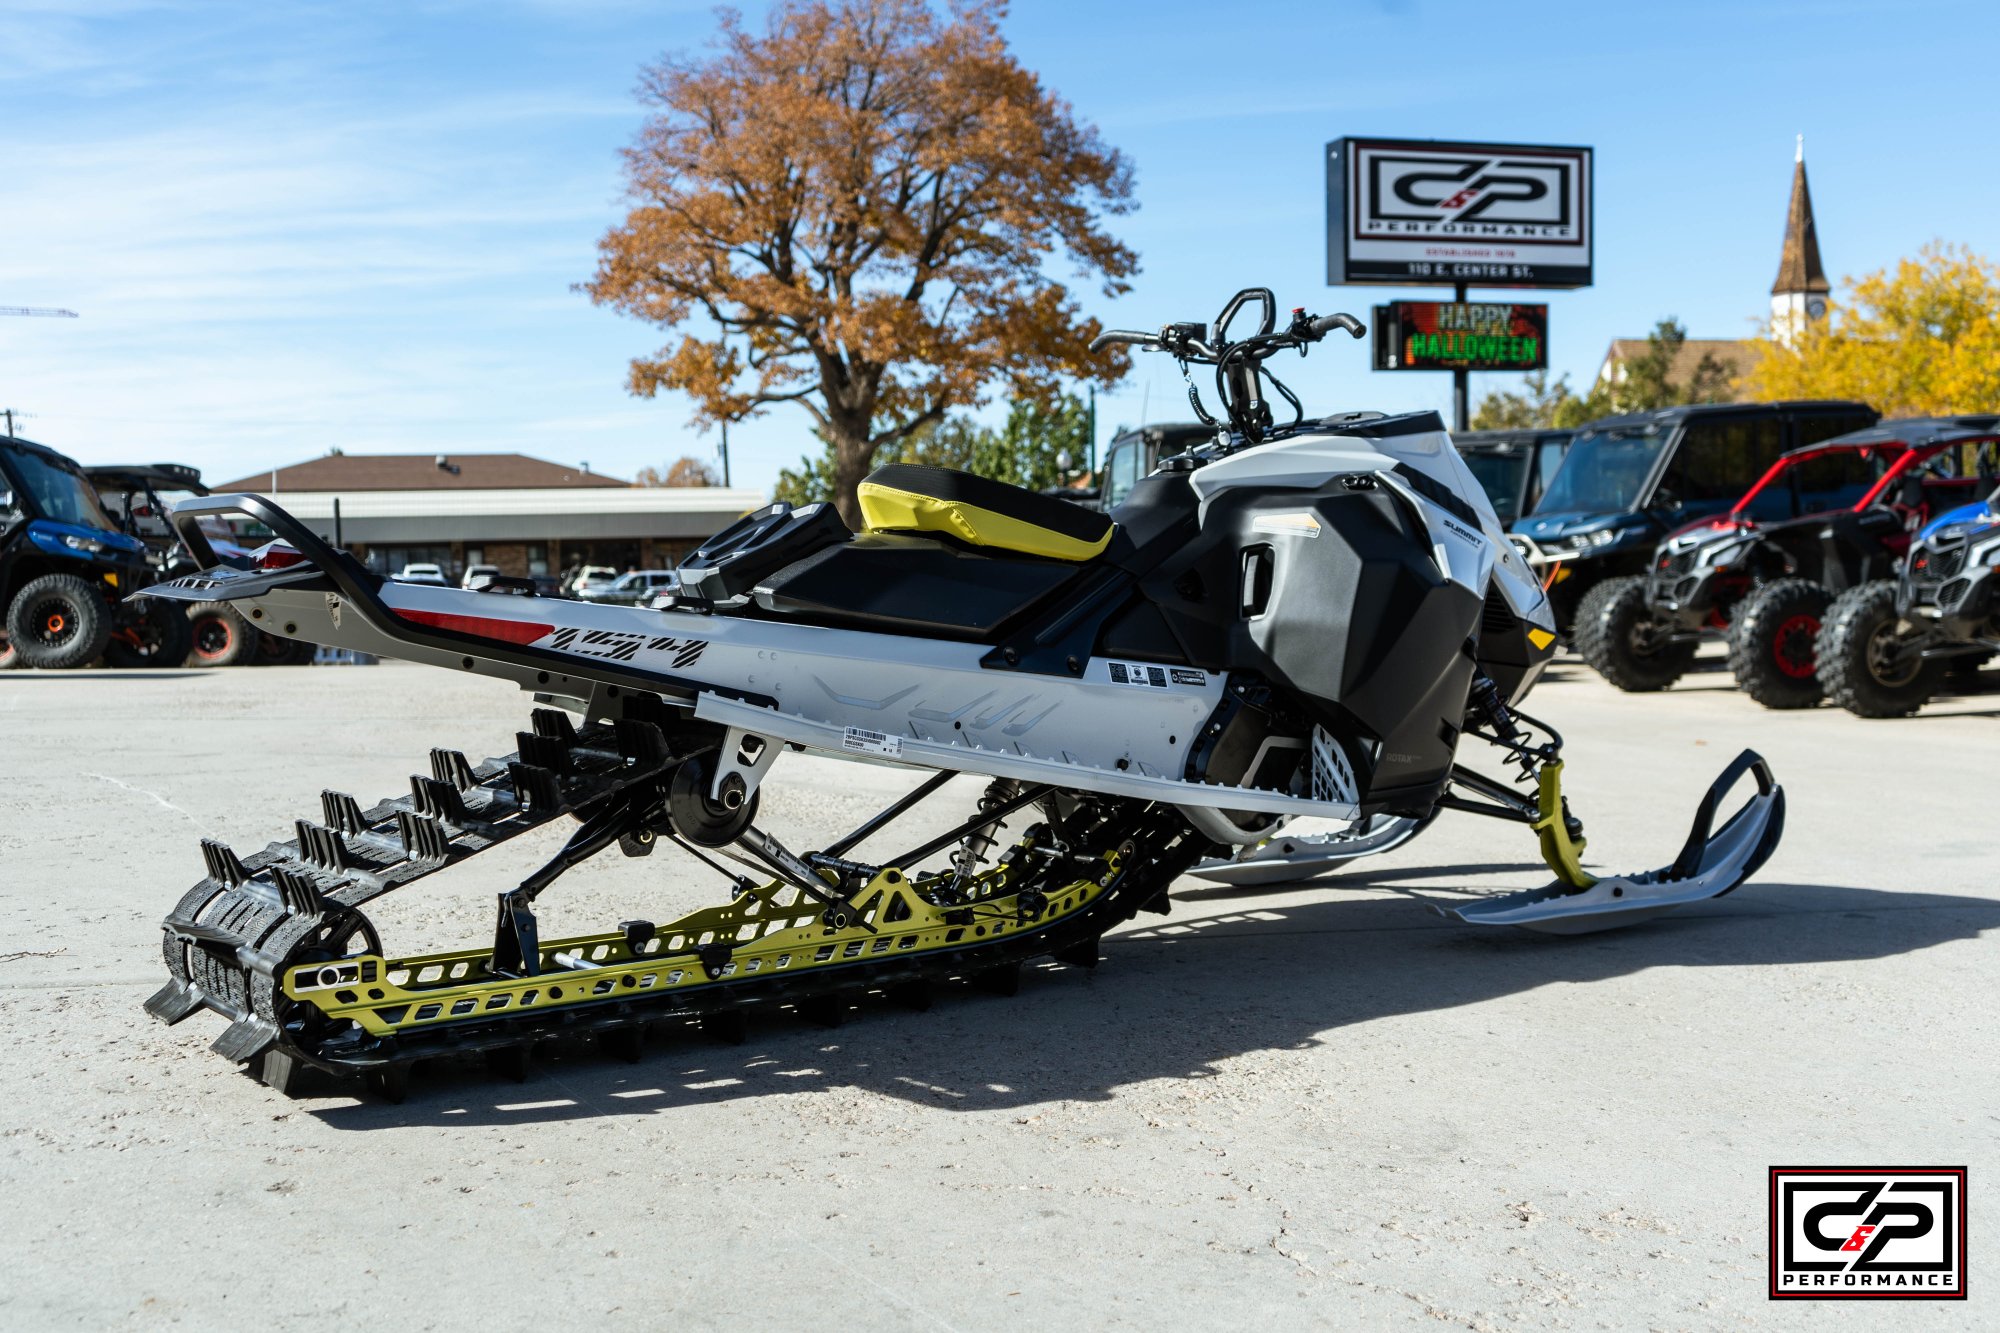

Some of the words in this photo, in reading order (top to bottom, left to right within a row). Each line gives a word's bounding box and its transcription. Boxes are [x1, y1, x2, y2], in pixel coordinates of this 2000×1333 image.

[1368, 221, 1571, 237] PERFORMANCE
[1408, 262, 1431, 275] 110
[1435, 263, 1449, 276] E.
[1453, 263, 1508, 277] CENTER
[1512, 264, 1534, 278] ST.
[1439, 303, 1512, 330] HAPPY
[1412, 332, 1537, 361] HALLOWEEN
[1443, 520, 1482, 545] SUMMIT
[553, 627, 709, 668] 154
